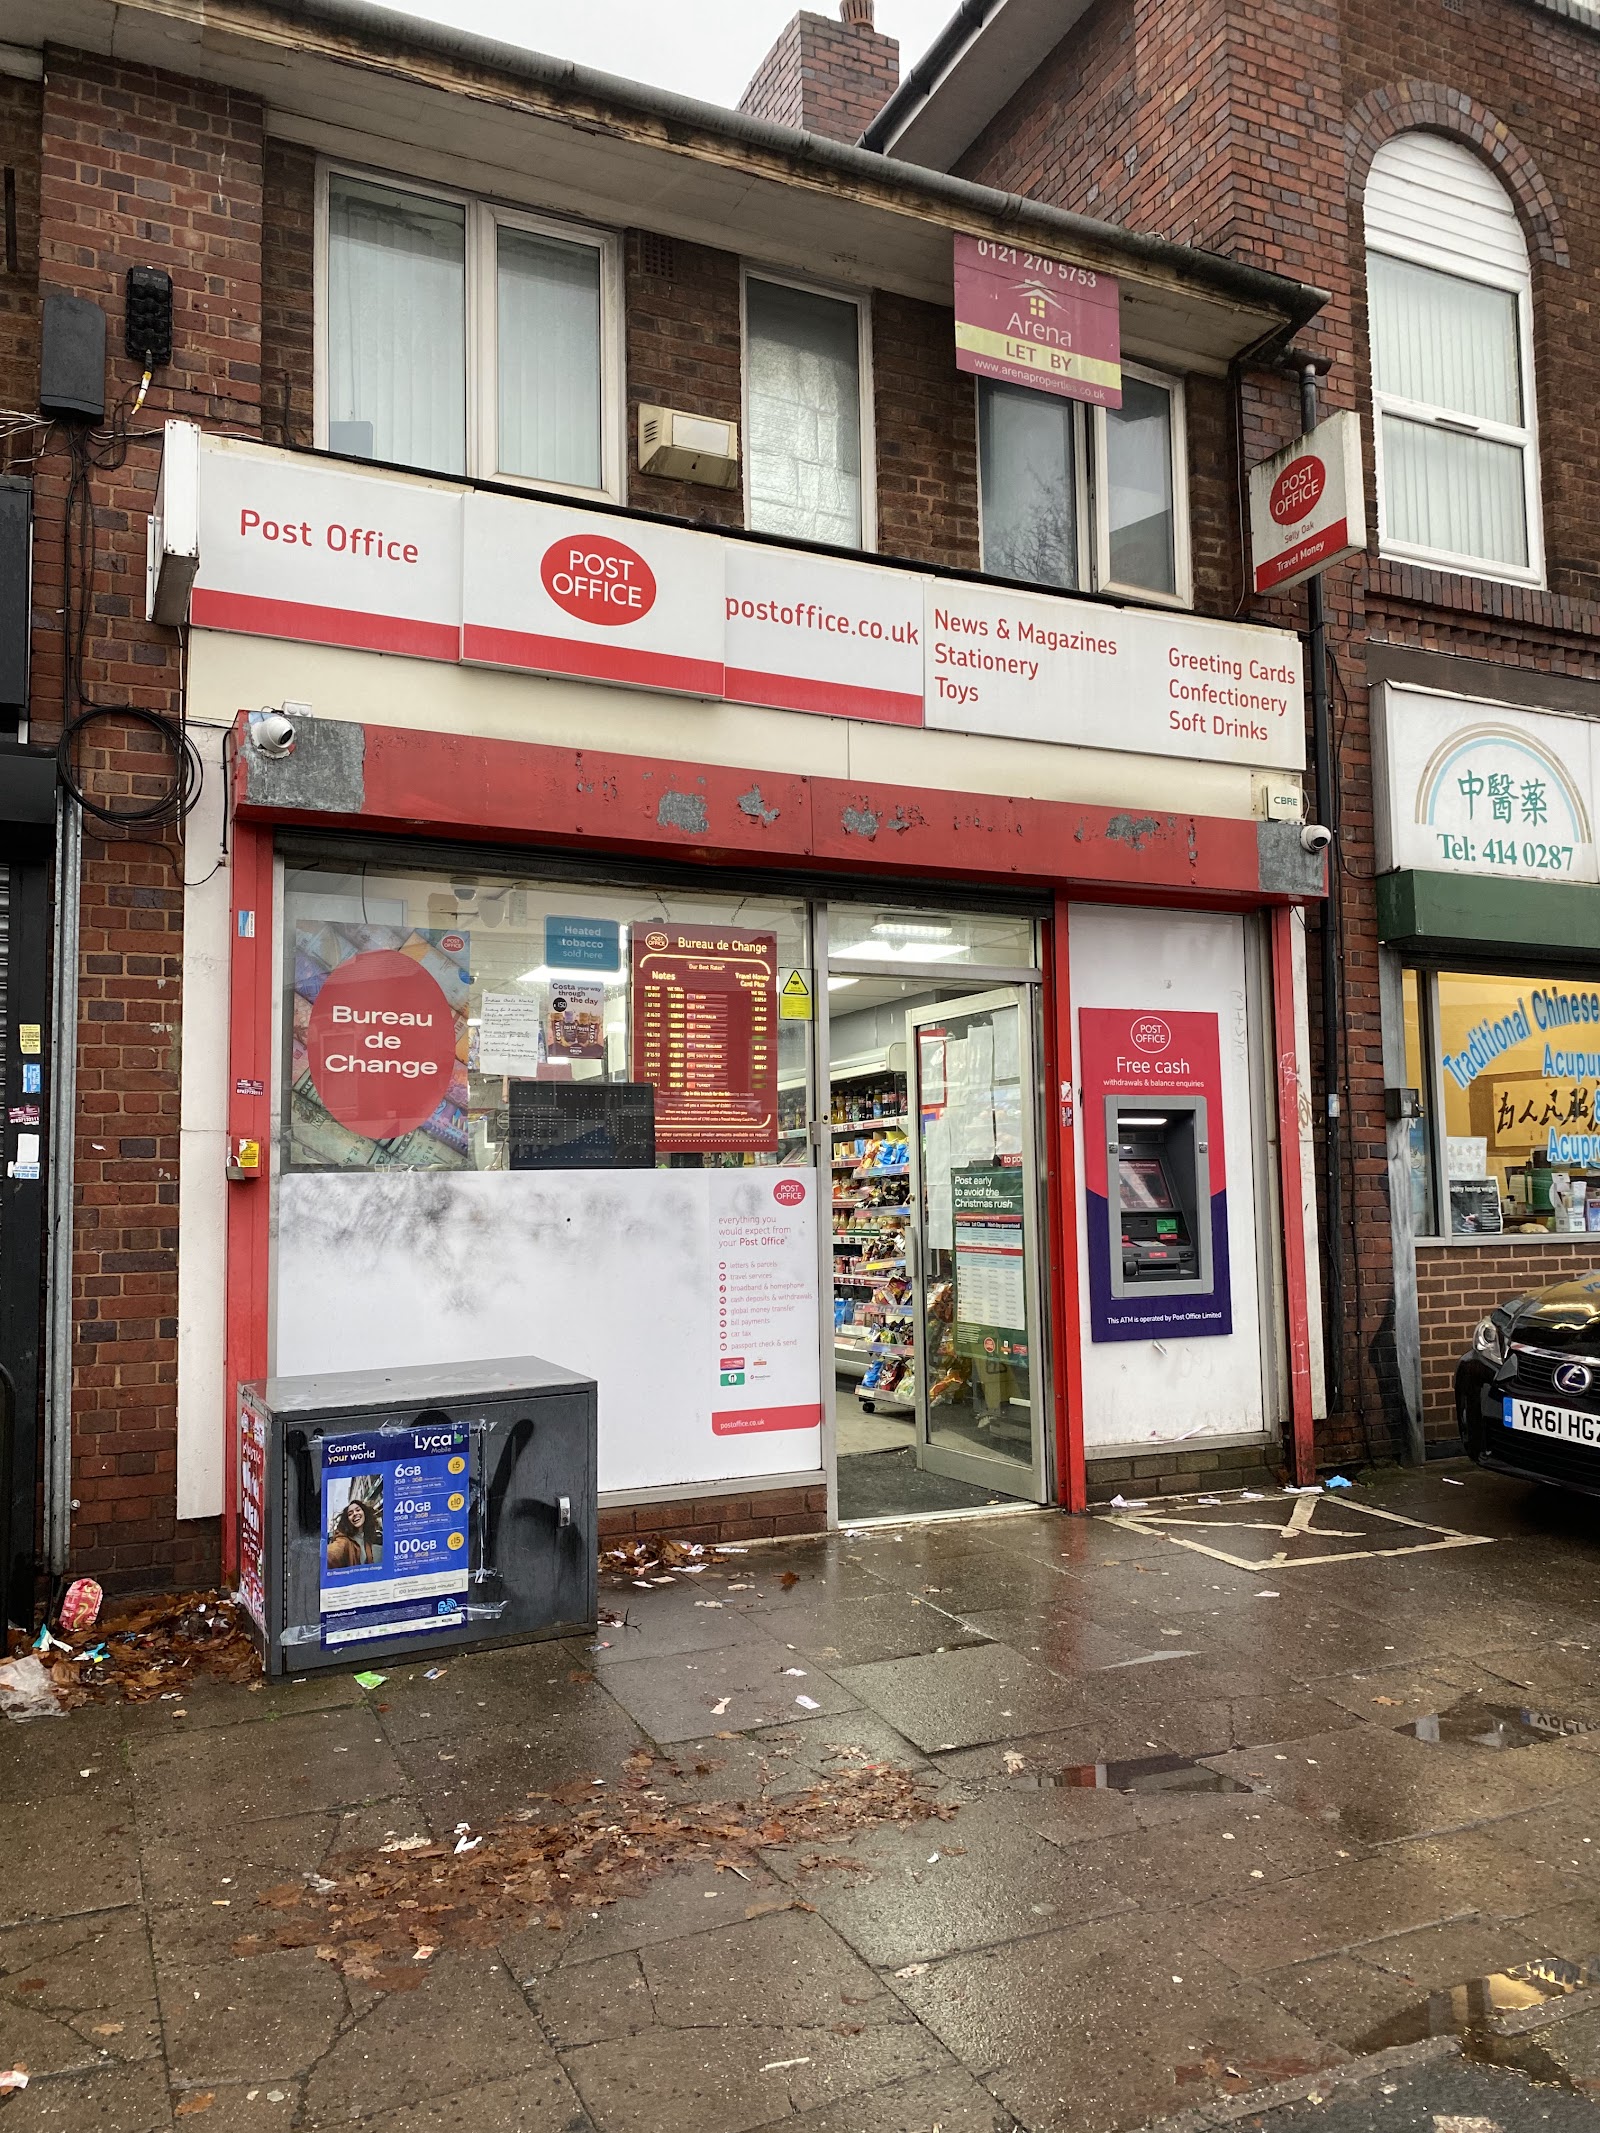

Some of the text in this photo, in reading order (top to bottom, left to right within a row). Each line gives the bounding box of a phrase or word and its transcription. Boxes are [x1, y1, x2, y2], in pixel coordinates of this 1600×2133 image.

[978, 239, 1097, 288] 0121 270 5753
[1006, 312, 1071, 347] Arena
[1006, 341, 1072, 372] LET BY
[1281, 464, 1314, 496] POST
[1275, 479, 1319, 516] OFFICE
[240, 509, 419, 564] Post Office
[1284, 521, 1315, 544] Selly Oak
[1277, 541, 1325, 572] Travel Money
[569, 550, 634, 581] POST
[552, 572, 642, 608] OFFICE
[725, 596, 919, 646] postoffice.co.uk
[934, 608, 1117, 656] News & Magazines
[934, 643, 1039, 681] Stationery
[1168, 647, 1295, 684] Greeting Cards
[934, 676, 979, 705] Toys
[1169, 679, 1287, 717] Confectionery
[1169, 710, 1268, 741] Soft Drinks
[1273, 796, 1298, 807] CBRE
[1436, 833, 1574, 872] Tel: 414 0287
[564, 925, 601, 936] Heated
[562, 938, 604, 949] tobacco
[678, 936, 767, 954] Bureau de Change
[562, 950, 603, 960] sold here
[652, 971, 676, 980] Notes
[735, 972, 770, 982] Travel Money
[584, 998, 599, 1006] day
[332, 1005, 432, 1027] Bureau
[1140, 1024, 1162, 1034] POST
[365, 1031, 401, 1050] de
[1136, 1034, 1165, 1044] OFFICE
[1443, 986, 1600, 1090] Traditional Chinese
[325, 1054, 438, 1079] Change
[1116, 1056, 1190, 1075] Free cash
[1543, 1043, 1600, 1083] Acupu
[1103, 1078, 1143, 1087] withdrawals
[1150, 1079, 1175, 1087] balance
[1176, 1080, 1204, 1088] enquiries
[1548, 1127, 1600, 1168] Acupr
[1003, 1155, 1011, 1164] to
[954, 1175, 993, 1186] Post early
[776, 1192, 802, 1200] OFFICE
[954, 1187, 1000, 1197] to avoid the
[954, 1198, 1013, 1209] Christmas rush
[718, 1216, 776, 1225] everything you
[718, 1226, 791, 1236] would expect from
[718, 1236, 786, 1249] your Post Office
[757, 1261, 778, 1269] parcels
[730, 1284, 762, 1292] broadband
[770, 1282, 804, 1290] homephone
[746, 1295, 770, 1303] deposits
[730, 1307, 748, 1315] global
[1120, 1316, 1133, 1324] ATM
[1140, 1315, 1164, 1323] operated
[1164, 1314, 1172, 1322] by
[1185, 1312, 1201, 1320] Office
[1202, 1311, 1222, 1319] Limited
[741, 1318, 770, 1326] payments
[731, 1342, 757, 1350] passport
[720, 1419, 765, 1430] postoffice.co.uk
[1519, 1404, 1562, 1434] YR61
[328, 1441, 366, 1454] Connect
[414, 1434, 452, 1451] Lyca
[328, 1450, 376, 1465] your world
[394, 1464, 421, 1478] 6GB
[452, 1461, 461, 1469] £5
[394, 1499, 432, 1514] 40GB
[451, 1497, 461, 1506] £10
[394, 1539, 437, 1554] 100GB
[451, 1536, 461, 1545] £15
[408, 1585, 436, 1593] International
